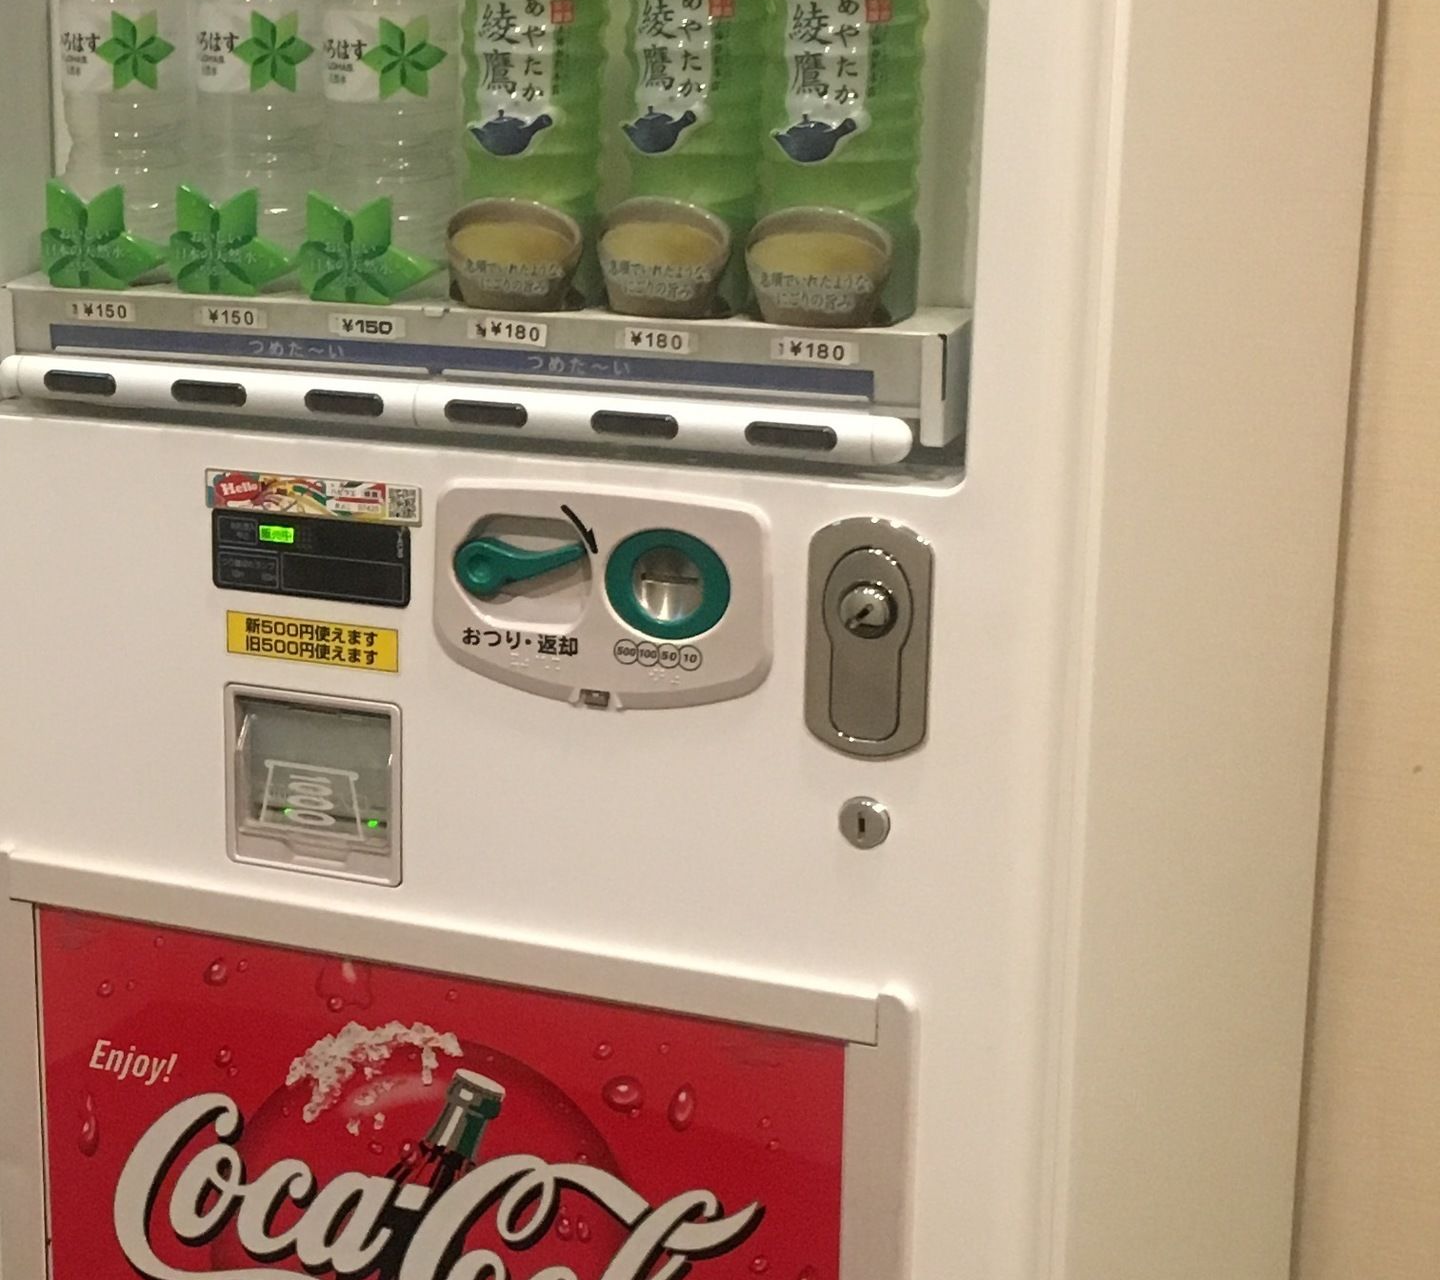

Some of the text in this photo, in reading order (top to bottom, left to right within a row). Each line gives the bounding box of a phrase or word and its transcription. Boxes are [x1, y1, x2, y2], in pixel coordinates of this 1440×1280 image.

[480, 1, 521, 96] 綾鷹
[788, 1, 831, 98] 綾鷹
[82, 302, 128, 320] ¥150
[207, 308, 255, 326] ¥150
[341, 317, 394, 335] ¥150
[490, 321, 541, 343] ¥180
[629, 330, 684, 351] ¥180
[789, 339, 846, 362] ¥180
[218, 481, 259, 496] Hello
[245, 617, 379, 647] 新500円使えます
[461, 626, 579, 658] おつり・返却
[245, 634, 379, 666] 旧500円使えます
[616, 644, 699, 665] 500 100 50 10
[285, 773, 337, 827] 1000
[88, 1038, 178, 1084] Enjoy!
